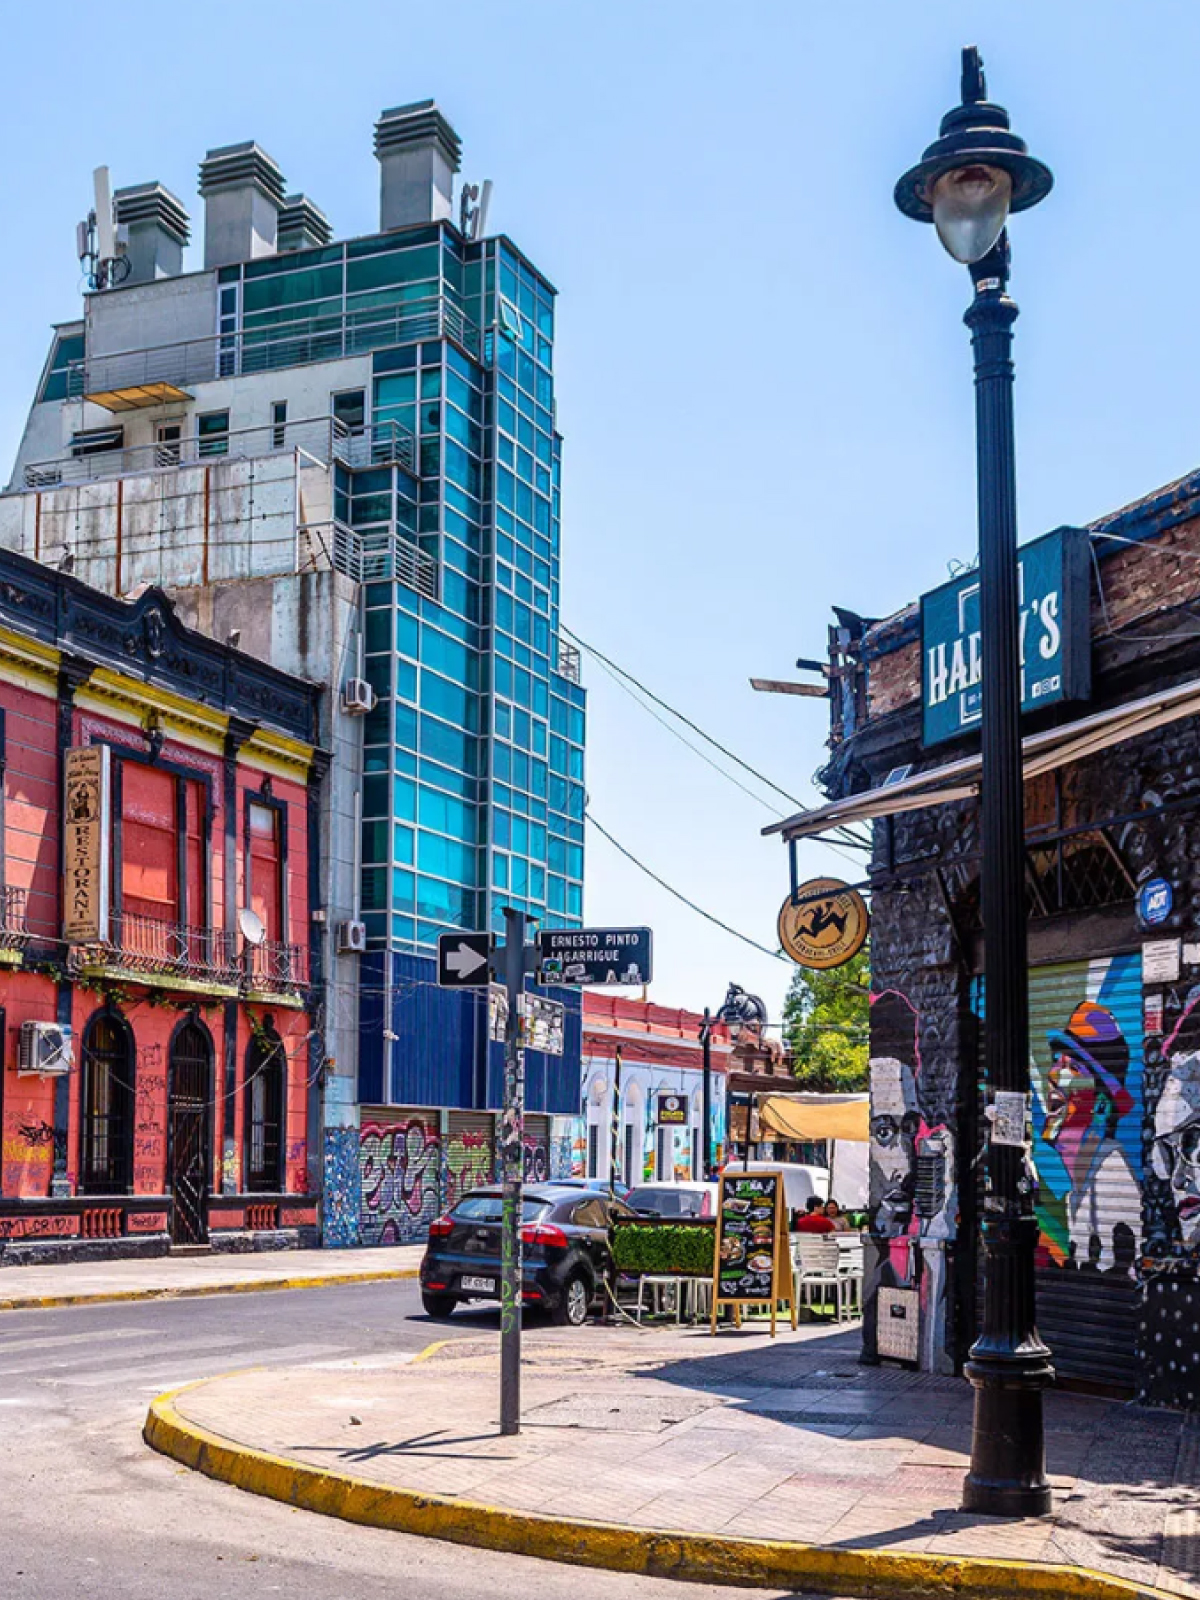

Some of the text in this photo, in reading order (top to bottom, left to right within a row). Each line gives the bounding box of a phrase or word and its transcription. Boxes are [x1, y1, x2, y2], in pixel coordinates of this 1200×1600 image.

[926, 591, 1060, 707] HAR'S
[74, 826, 90, 918] RESTORANT
[551, 933, 639, 947] ERNESTO PINTO
